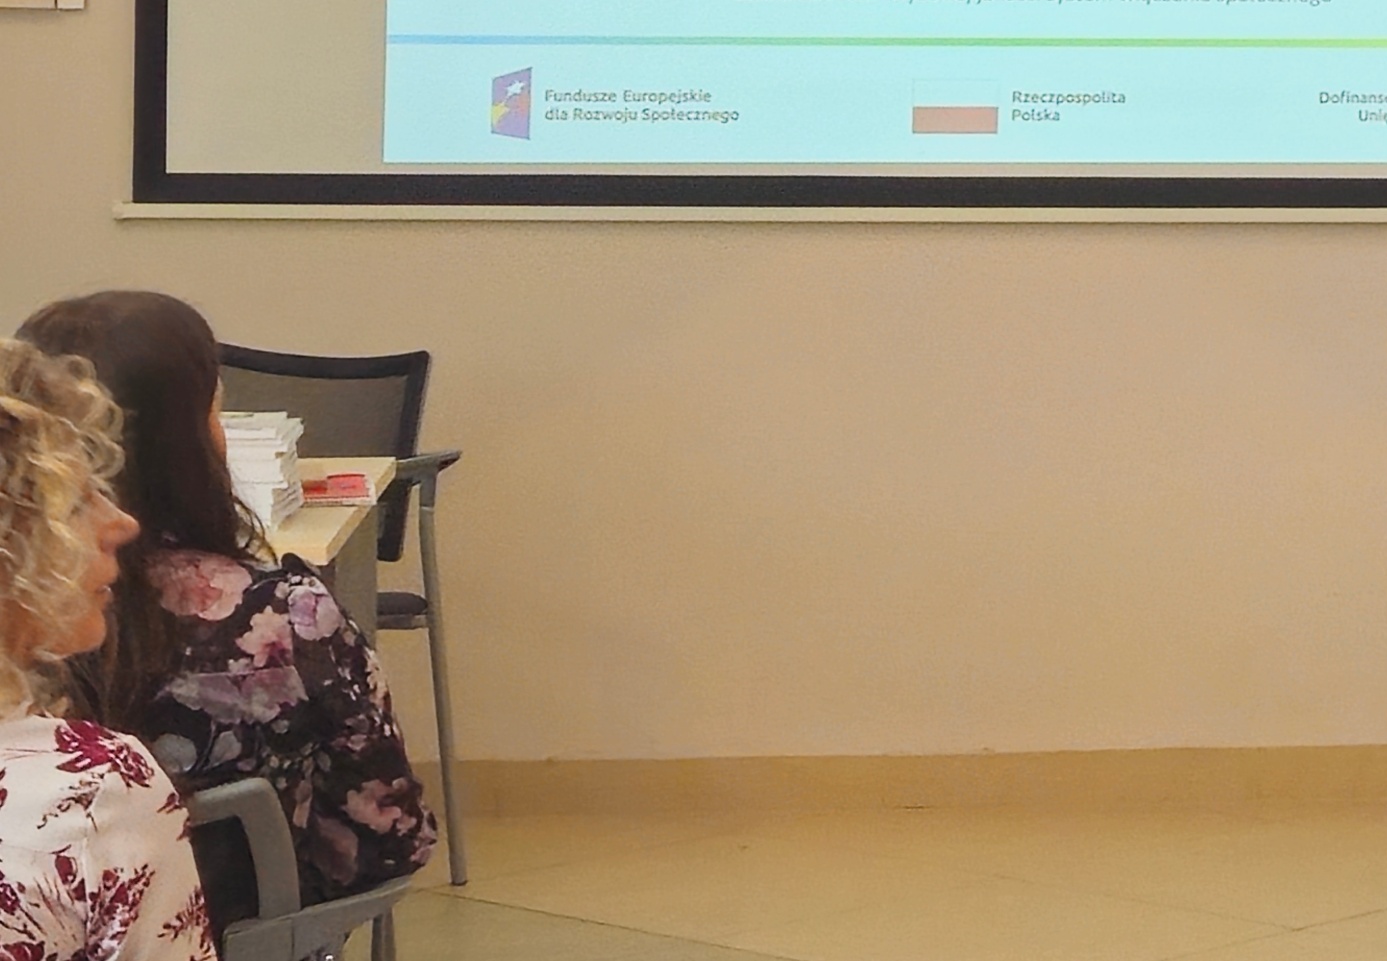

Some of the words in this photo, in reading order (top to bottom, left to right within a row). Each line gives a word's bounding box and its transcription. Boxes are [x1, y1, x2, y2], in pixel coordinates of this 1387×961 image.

[545, 88, 617, 103] Fundusze
[623, 88, 712, 105] Europejskie
[1011, 90, 1127, 107] Rzeczpospolita
[545, 107, 568, 121] dla
[573, 107, 638, 124] Rozwoju
[642, 108, 740, 124] Społecznego
[1011, 108, 1060, 122] Polska
